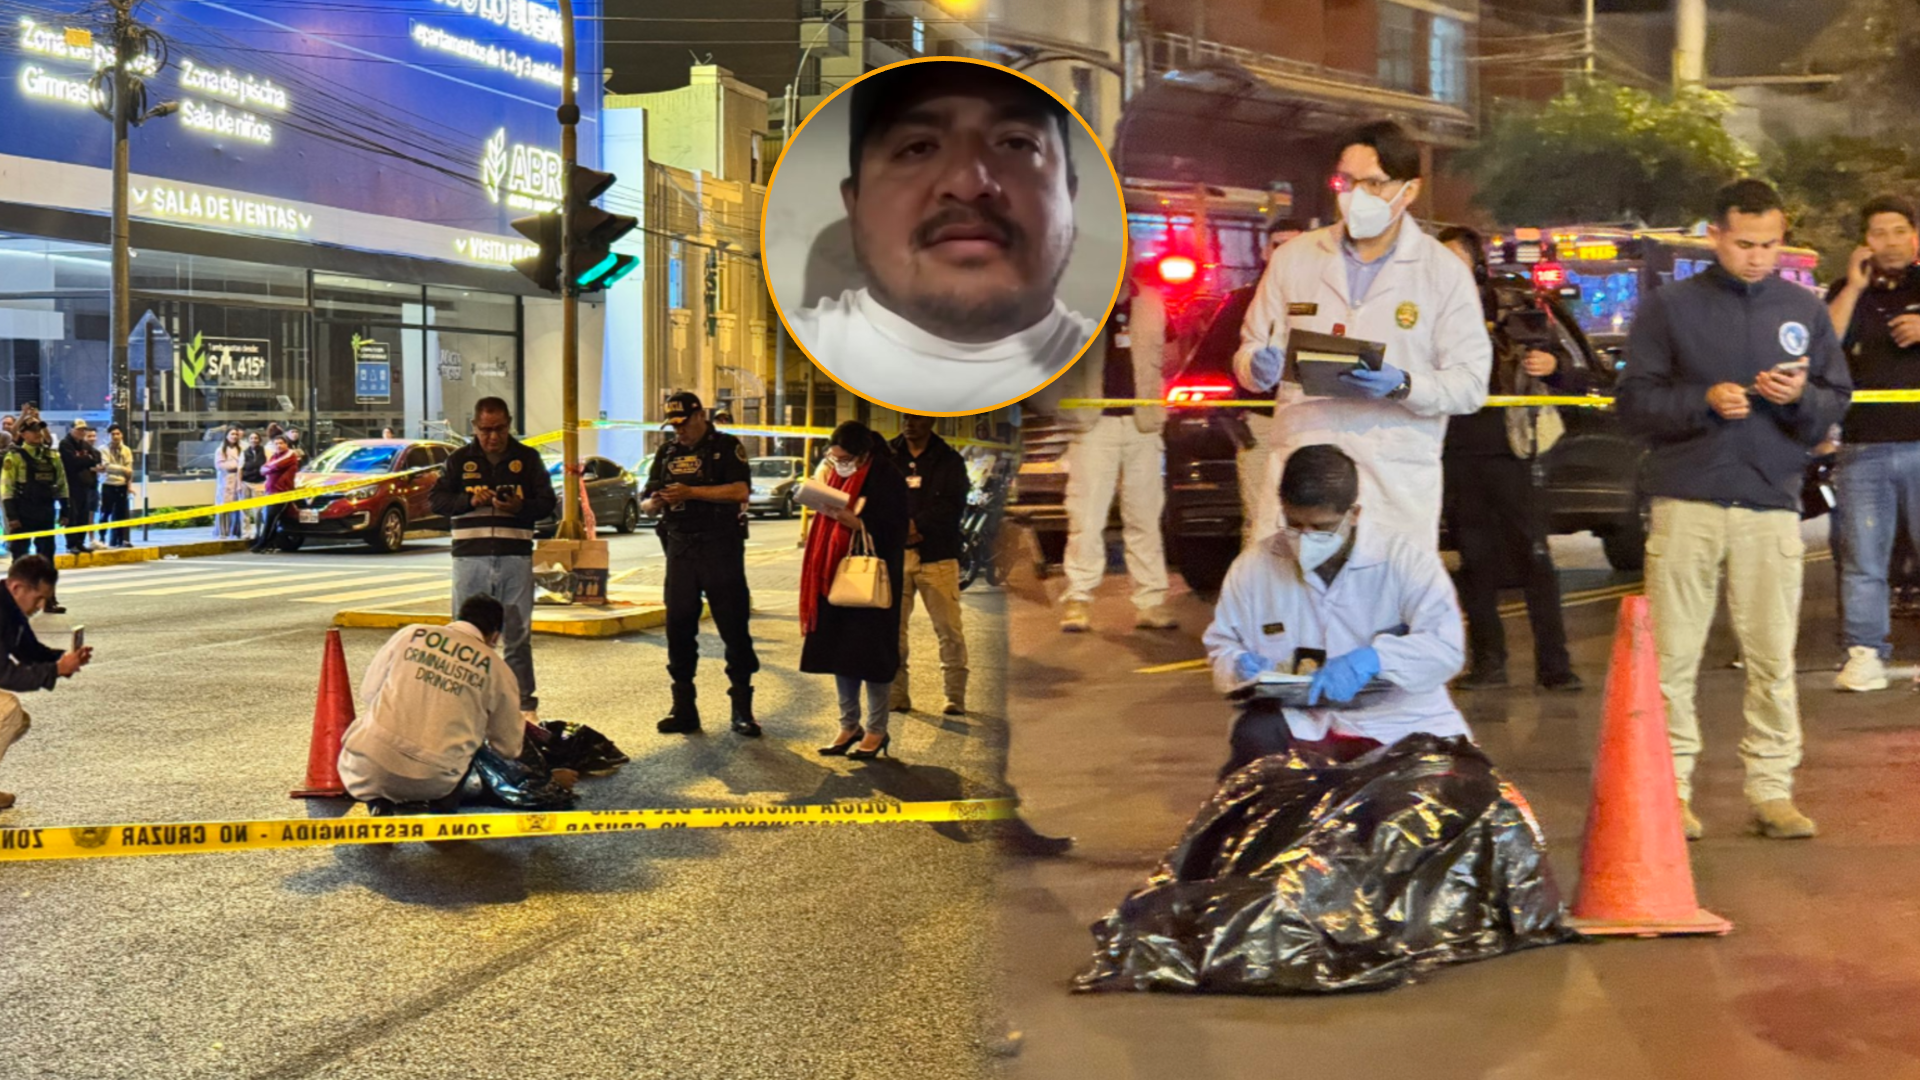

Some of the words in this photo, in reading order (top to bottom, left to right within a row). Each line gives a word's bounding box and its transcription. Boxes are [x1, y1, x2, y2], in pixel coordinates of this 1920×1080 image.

[21, 19, 67, 55] Zona
[509, 0, 563, 47] BUEN
[486, 45, 500, 66] de
[509, 52, 517, 71] 2
[517, 58, 524, 77] y
[524, 56, 531, 76] 3
[181, 60, 218, 91] Zona
[221, 70, 239, 96] de
[240, 75, 286, 109] piscina
[182, 100, 214, 130] Sala
[215, 108, 234, 133] de
[509, 144, 562, 199] ABR
[153, 186, 203, 218] SALA
[206, 195, 230, 220] DE
[231, 198, 298, 230] VENTAS
[470, 237, 507, 262] VISITA
[410, 628, 492, 674] POLICIA
